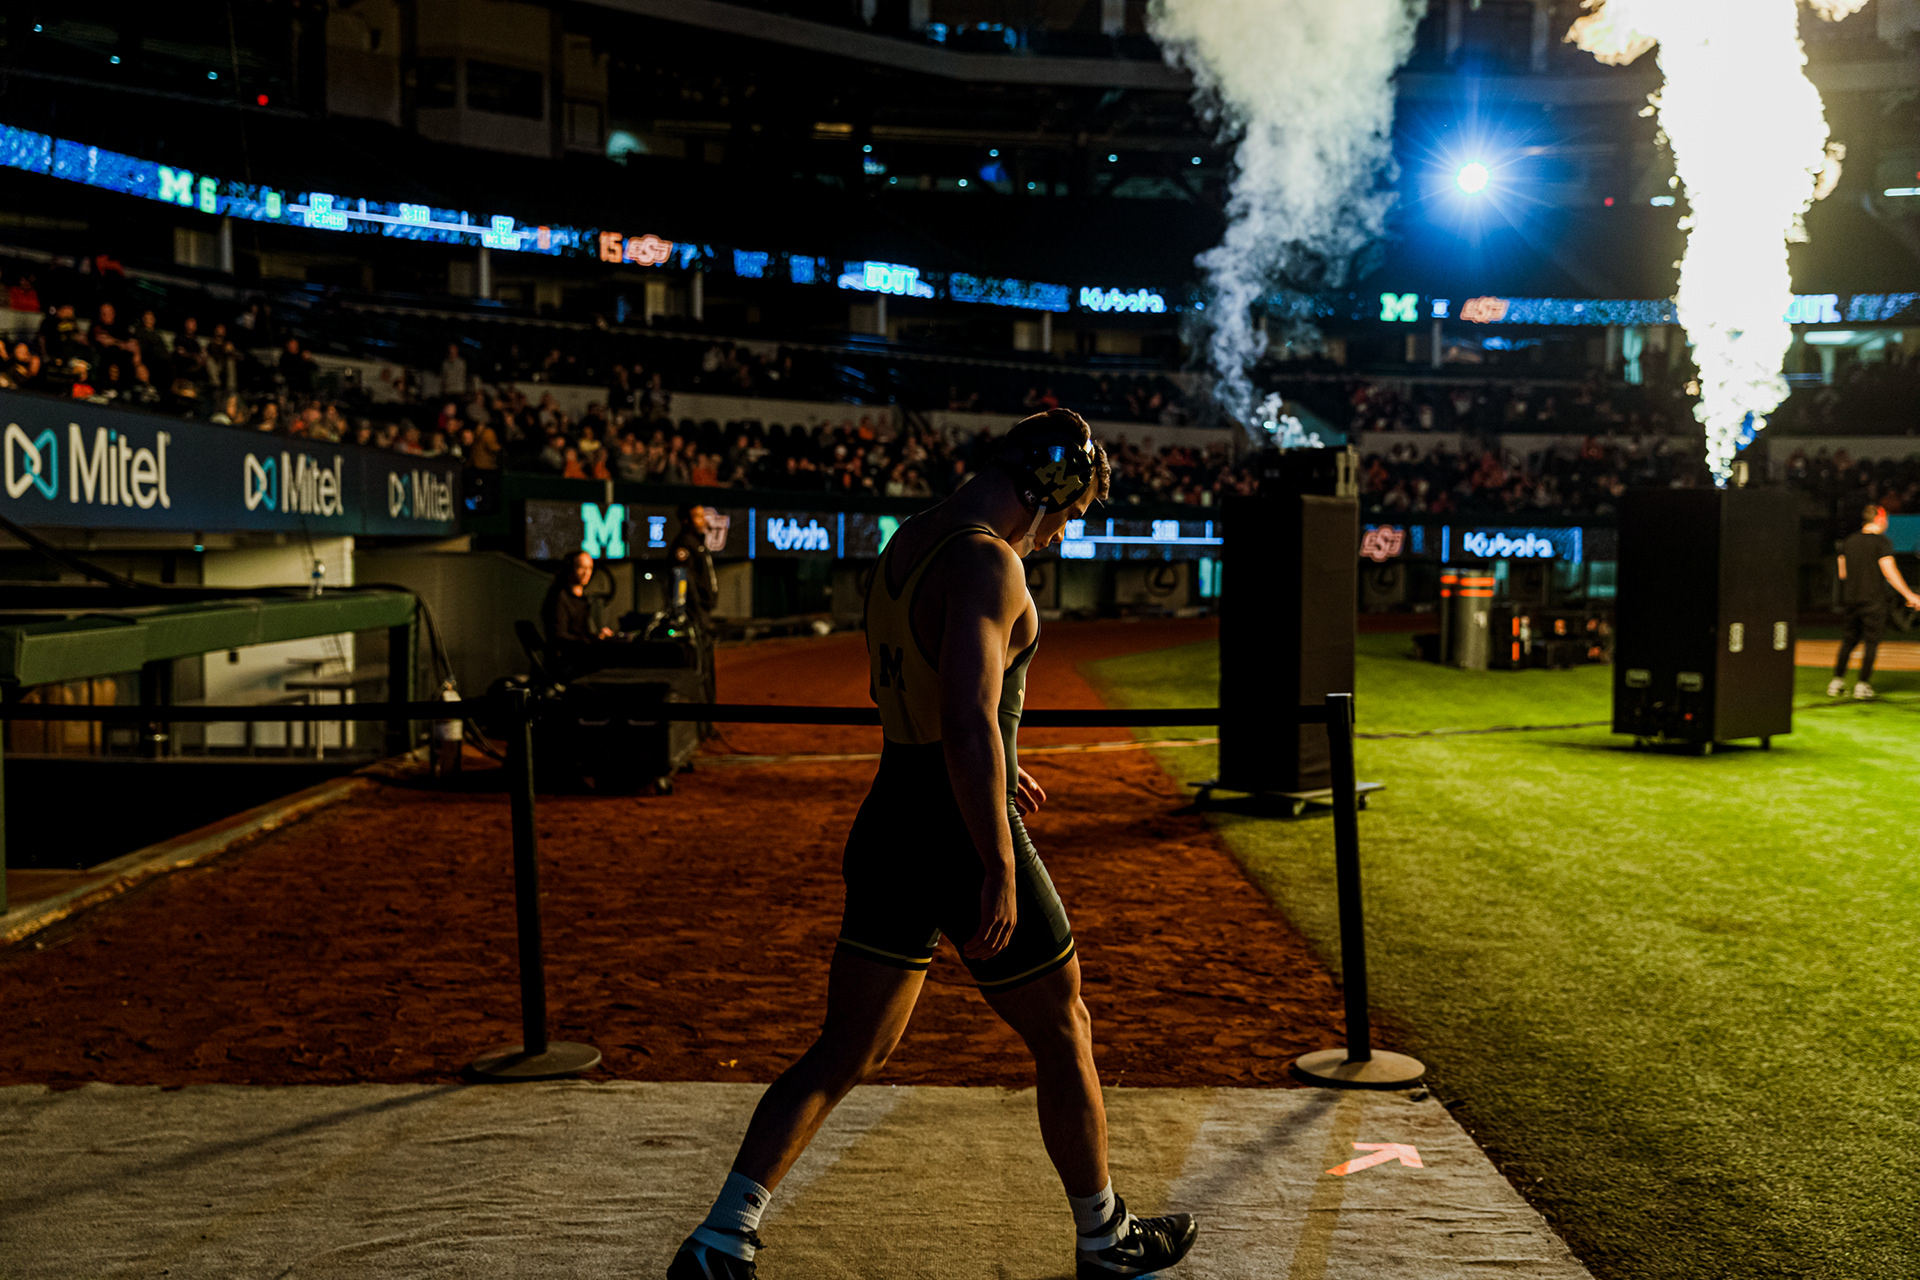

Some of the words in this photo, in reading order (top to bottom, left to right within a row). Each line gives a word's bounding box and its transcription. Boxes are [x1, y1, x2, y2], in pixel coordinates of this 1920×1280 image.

[158, 165, 194, 206] M
[199, 176, 217, 214] 6
[599, 231, 623, 263] 15
[1380, 293, 1418, 322] M
[69, 423, 170, 509] Mitel
[281, 451, 344, 516] Mitel
[412, 469, 455, 522] Mitel
[581, 503, 625, 559] M
[1463, 532, 1555, 558] Kubota
